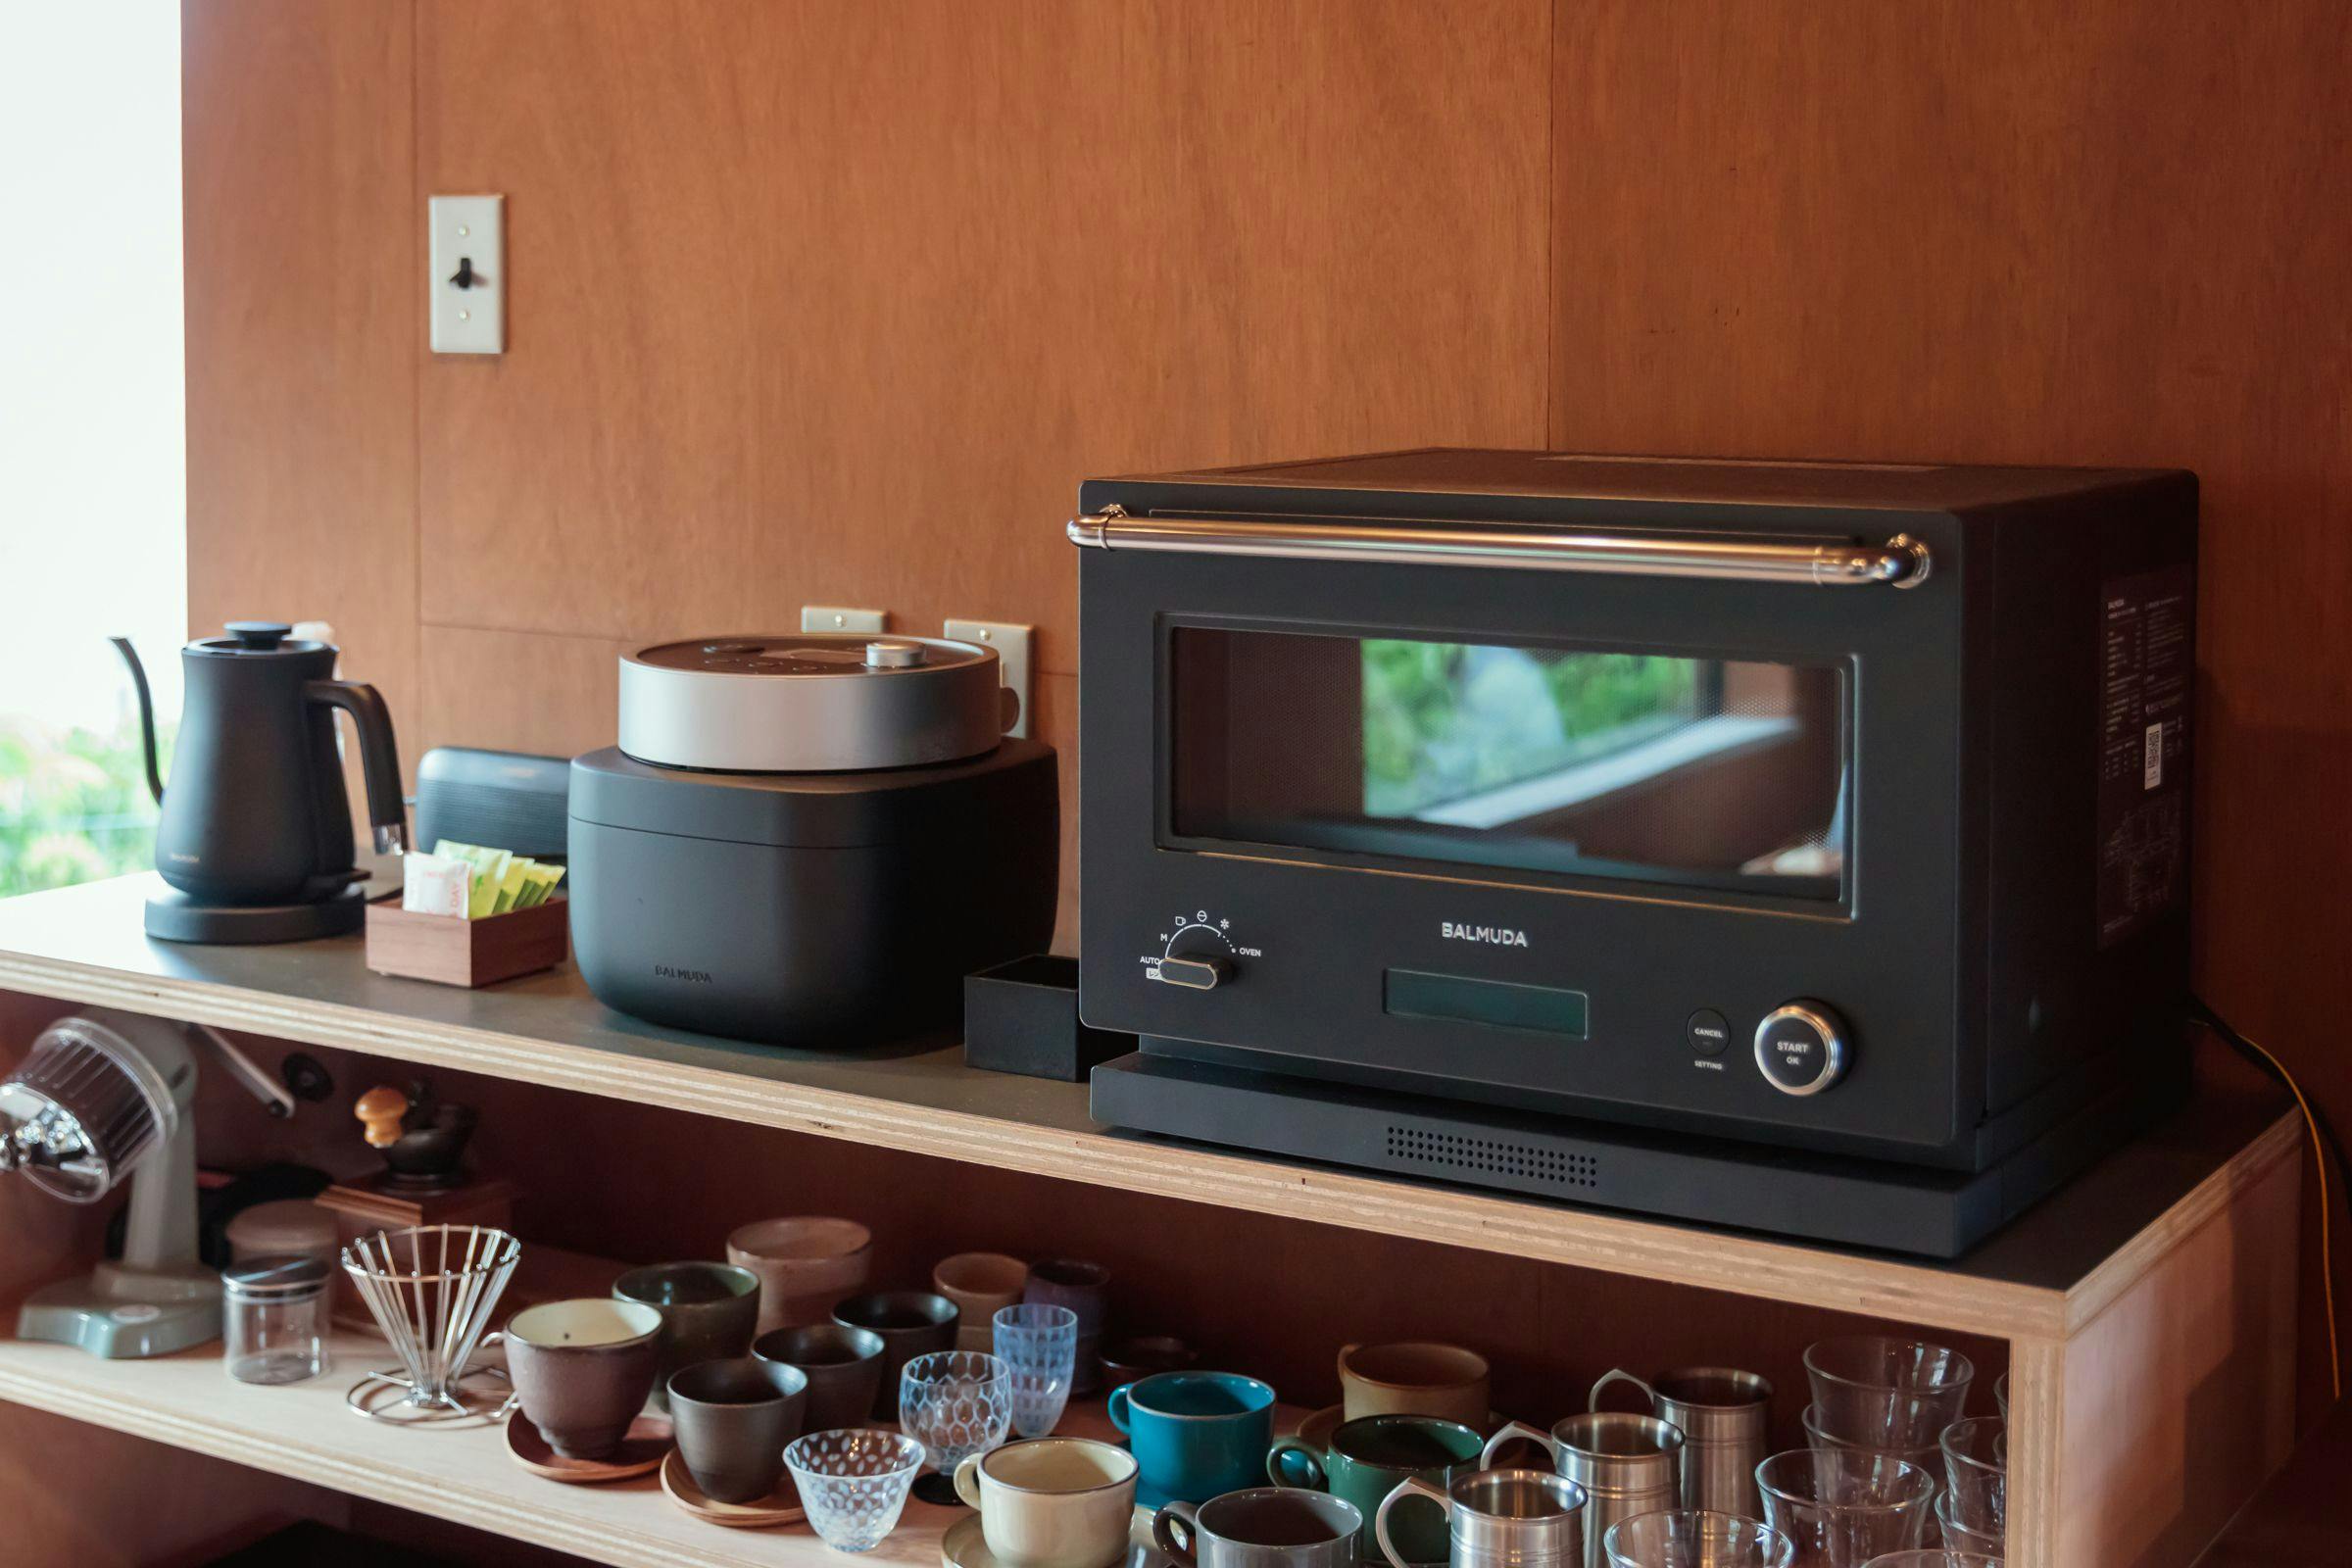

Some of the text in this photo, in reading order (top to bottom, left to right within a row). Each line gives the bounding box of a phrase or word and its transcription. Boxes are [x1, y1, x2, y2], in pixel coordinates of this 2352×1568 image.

[1160, 933, 1168, 942] M
[1442, 922, 1528, 948] BALMUDA
[1239, 947, 1261, 957] OVEN
[1140, 956, 1160, 965] AUTO
[1694, 1027, 1723, 1038] CANCEL
[1777, 1041, 1808, 1053] START
[1694, 1060, 1722, 1070] SETTING
[1787, 1056, 1799, 1065] OK
